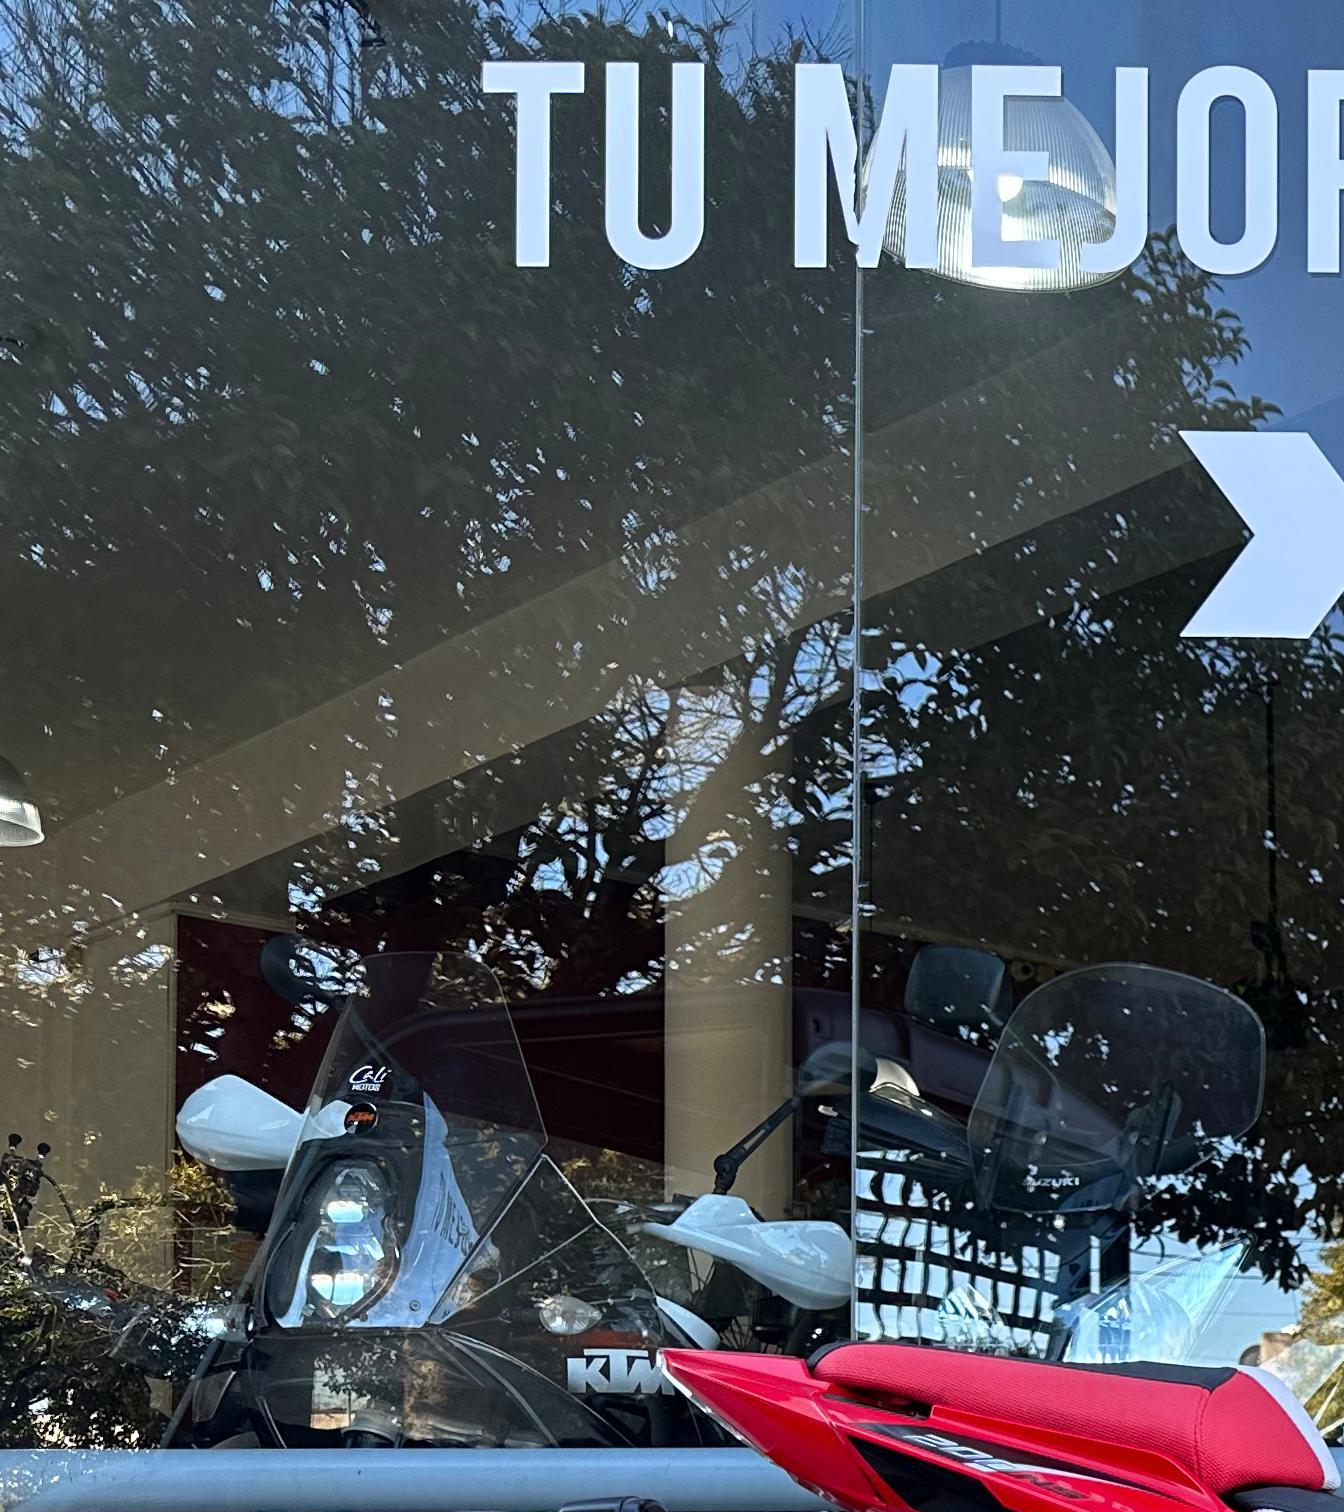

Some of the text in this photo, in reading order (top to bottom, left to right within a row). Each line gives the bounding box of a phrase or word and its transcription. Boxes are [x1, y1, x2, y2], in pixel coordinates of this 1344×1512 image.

[481, 60, 706, 272] TU
[349, 1065, 392, 1084] Cali
[566, 1348, 676, 1394] KTM
